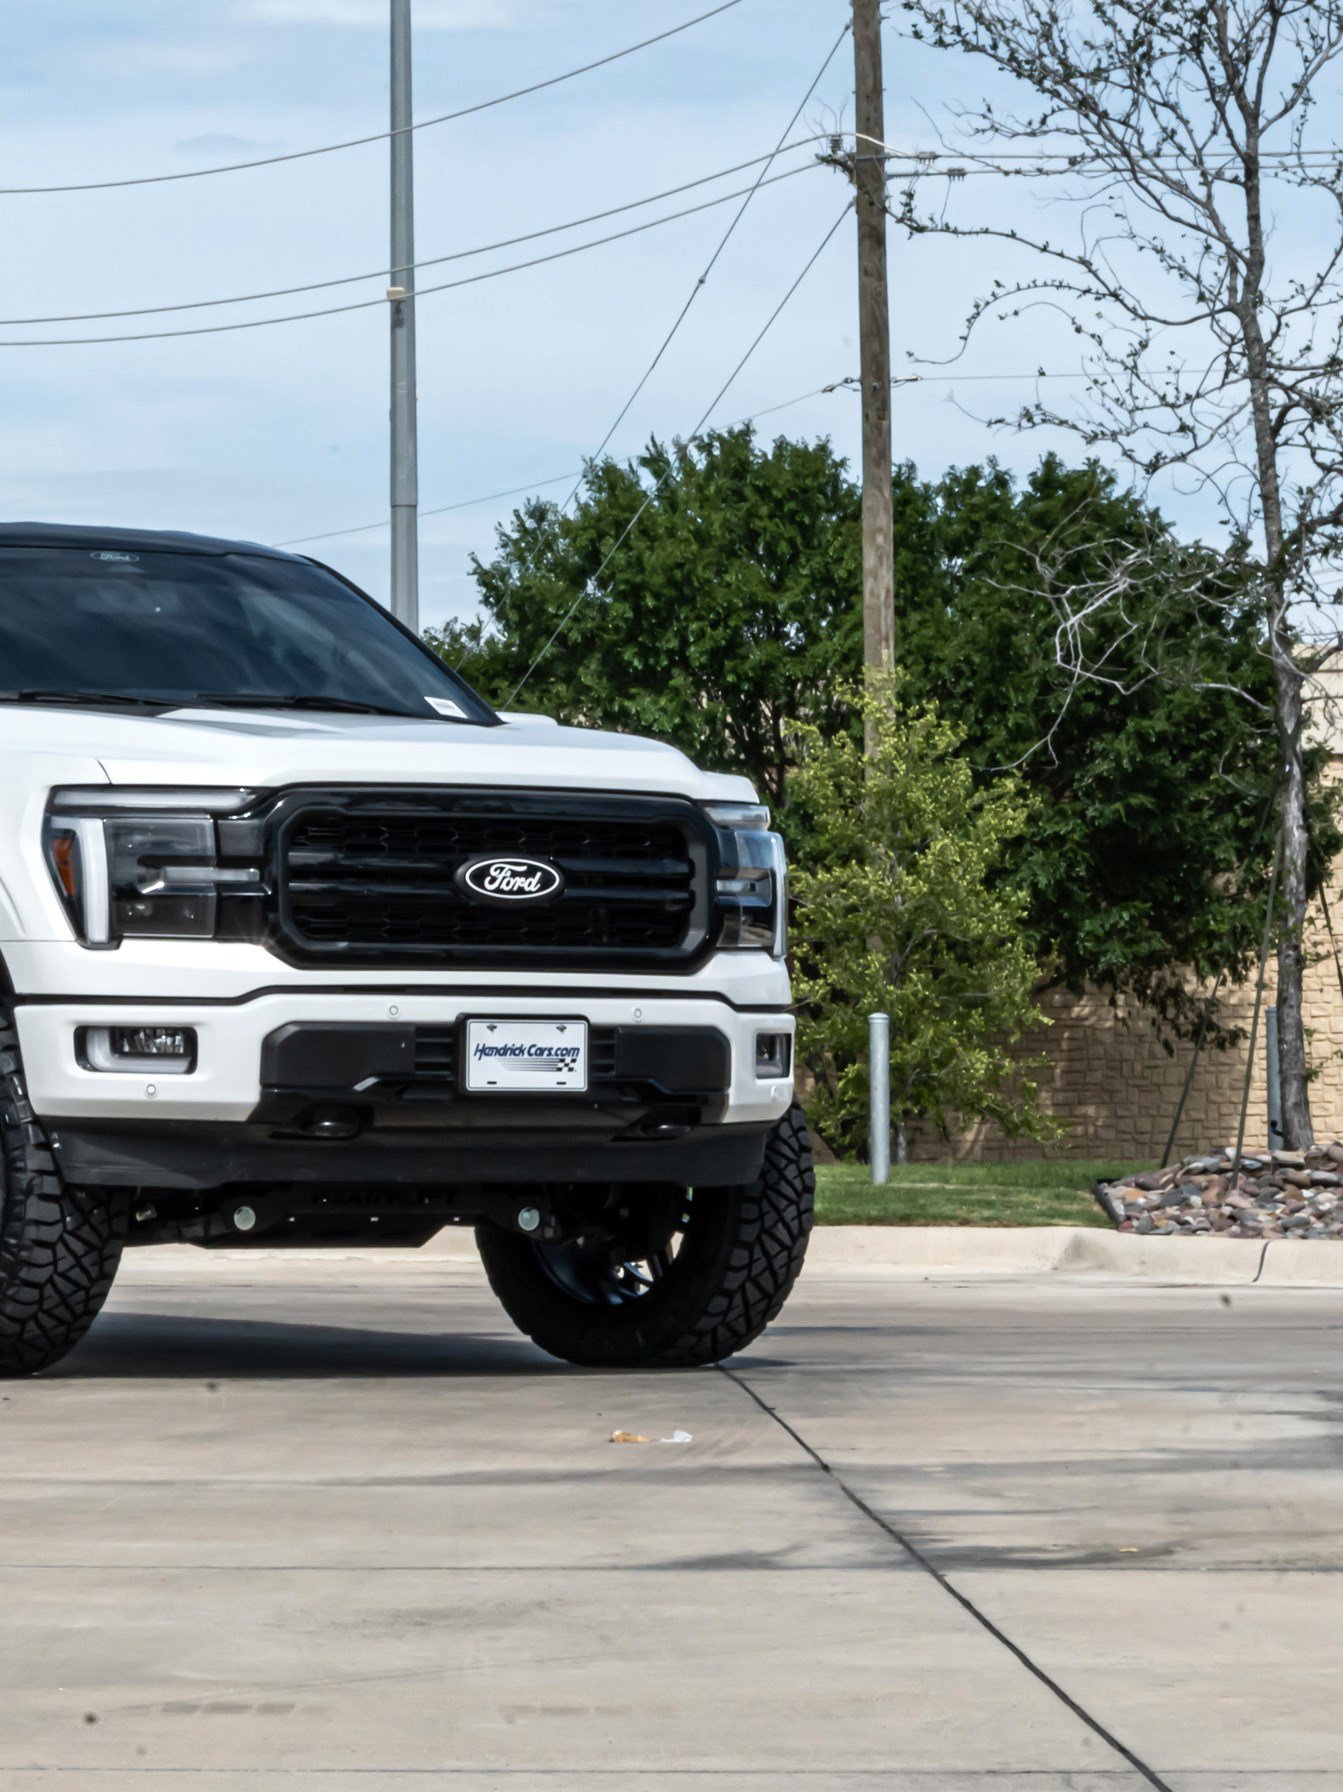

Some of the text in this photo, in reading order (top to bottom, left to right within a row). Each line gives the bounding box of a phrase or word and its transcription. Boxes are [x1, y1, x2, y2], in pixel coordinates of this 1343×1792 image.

[484, 863, 542, 892] Ford
[473, 1043, 581, 1061] Hendrick Cars.com
